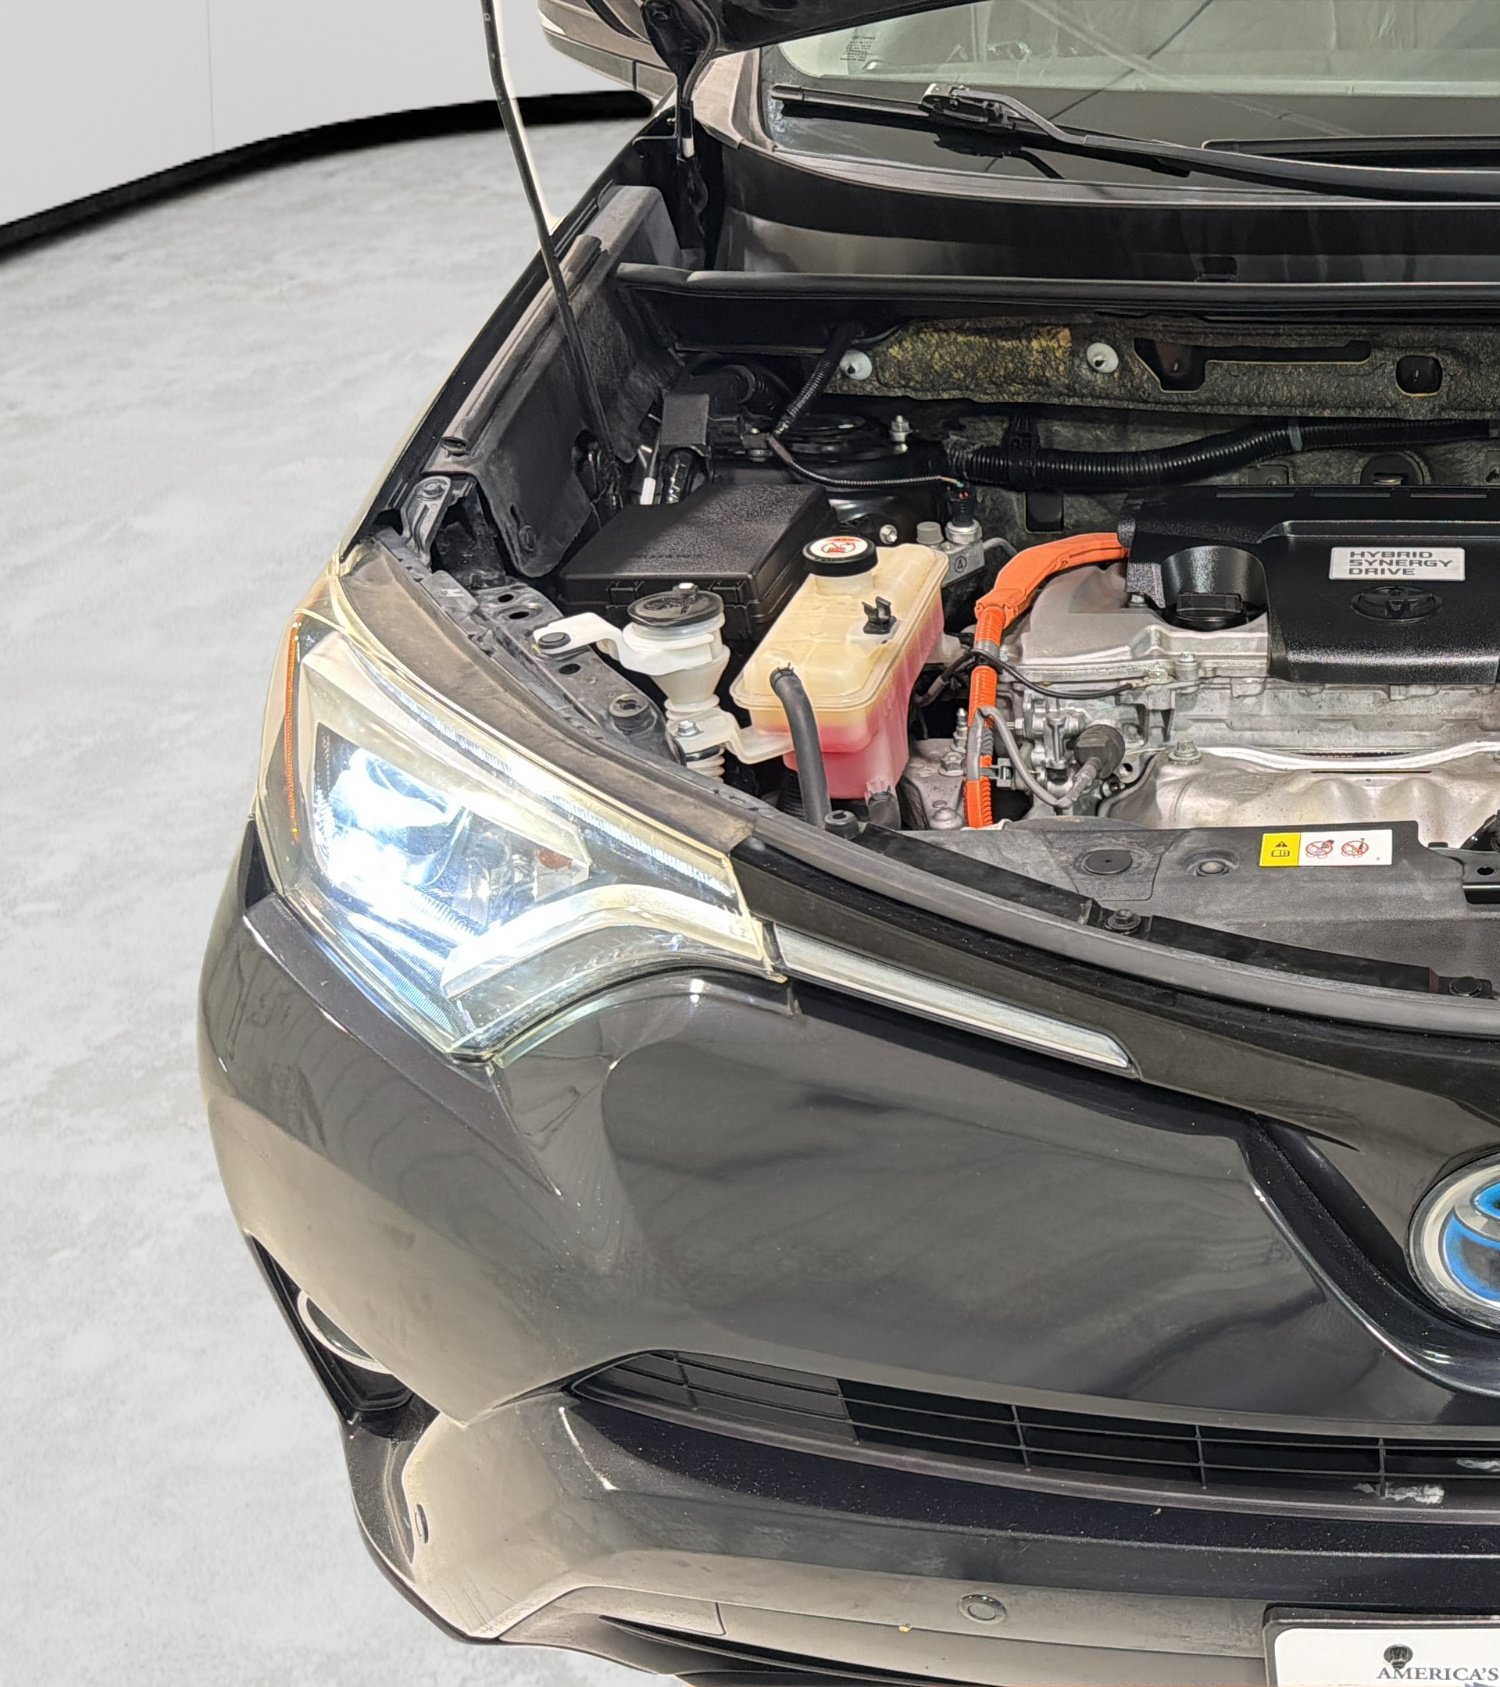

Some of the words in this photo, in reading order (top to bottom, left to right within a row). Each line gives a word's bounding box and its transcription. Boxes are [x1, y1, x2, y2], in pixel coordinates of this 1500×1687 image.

[1349, 551, 1433, 559] HYBRID
[1348, 559, 1453, 567] SYNERGY
[1348, 567, 1416, 576] DRIVE
